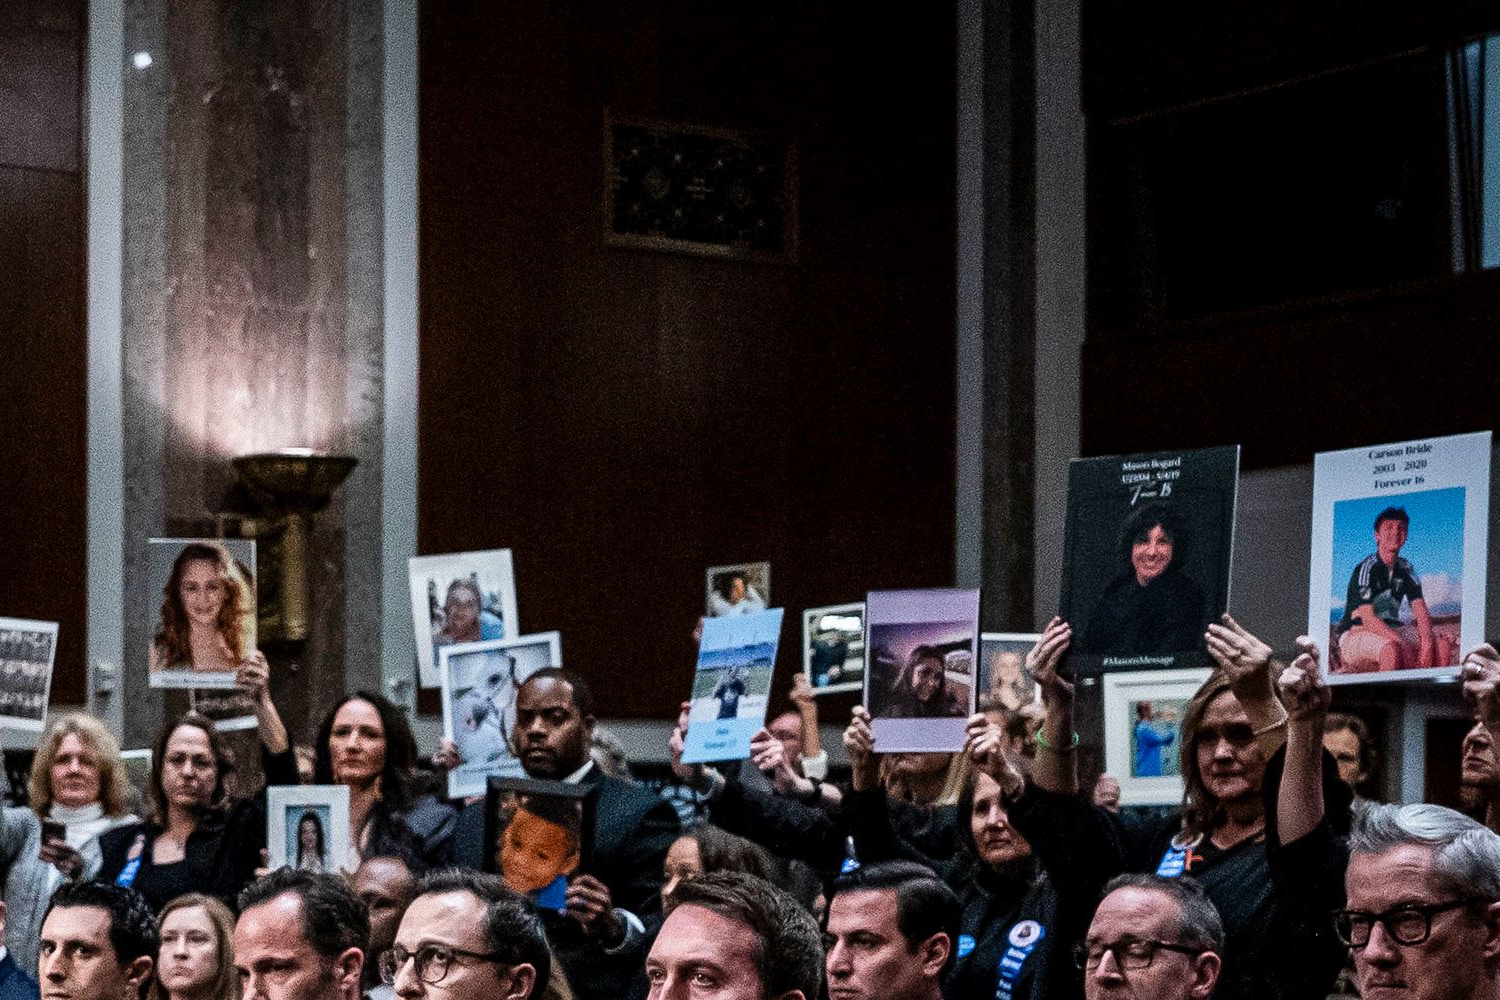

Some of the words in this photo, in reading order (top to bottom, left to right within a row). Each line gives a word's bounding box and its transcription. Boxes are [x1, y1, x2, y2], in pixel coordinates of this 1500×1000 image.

[1368, 449, 1403, 459] Carson
[1405, 443, 1432, 454] Bride
[1373, 463, 1396, 474] 2003
[1403, 460, 1427, 471] 2020
[1374, 478, 1412, 488] Forever
